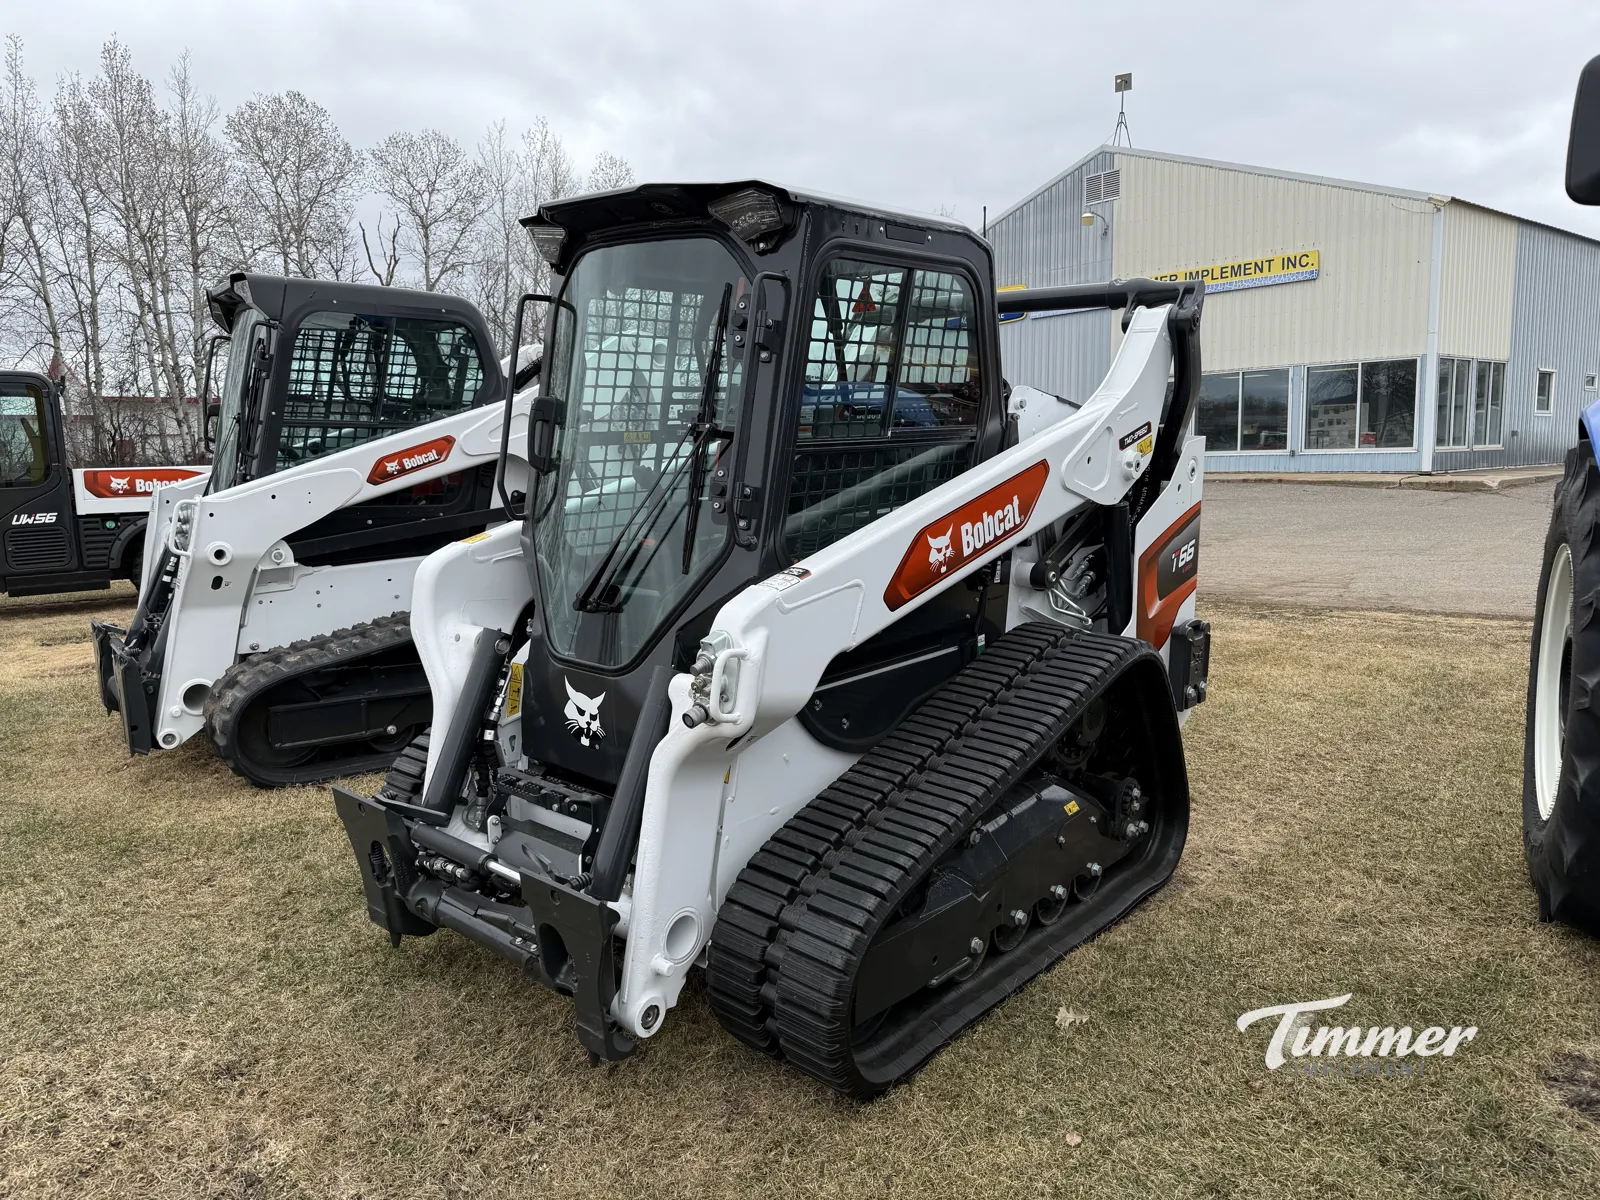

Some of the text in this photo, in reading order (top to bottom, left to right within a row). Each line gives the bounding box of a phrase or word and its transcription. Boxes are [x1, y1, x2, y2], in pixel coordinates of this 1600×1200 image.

[1184, 259, 1275, 281] IMPLEMENT
[1281, 253, 1315, 270] INC.
[402, 449, 439, 470] Bobcat
[135, 478, 183, 492] Bobc
[961, 495, 1020, 557] Bobcat
[1171, 538, 1196, 573] T66
